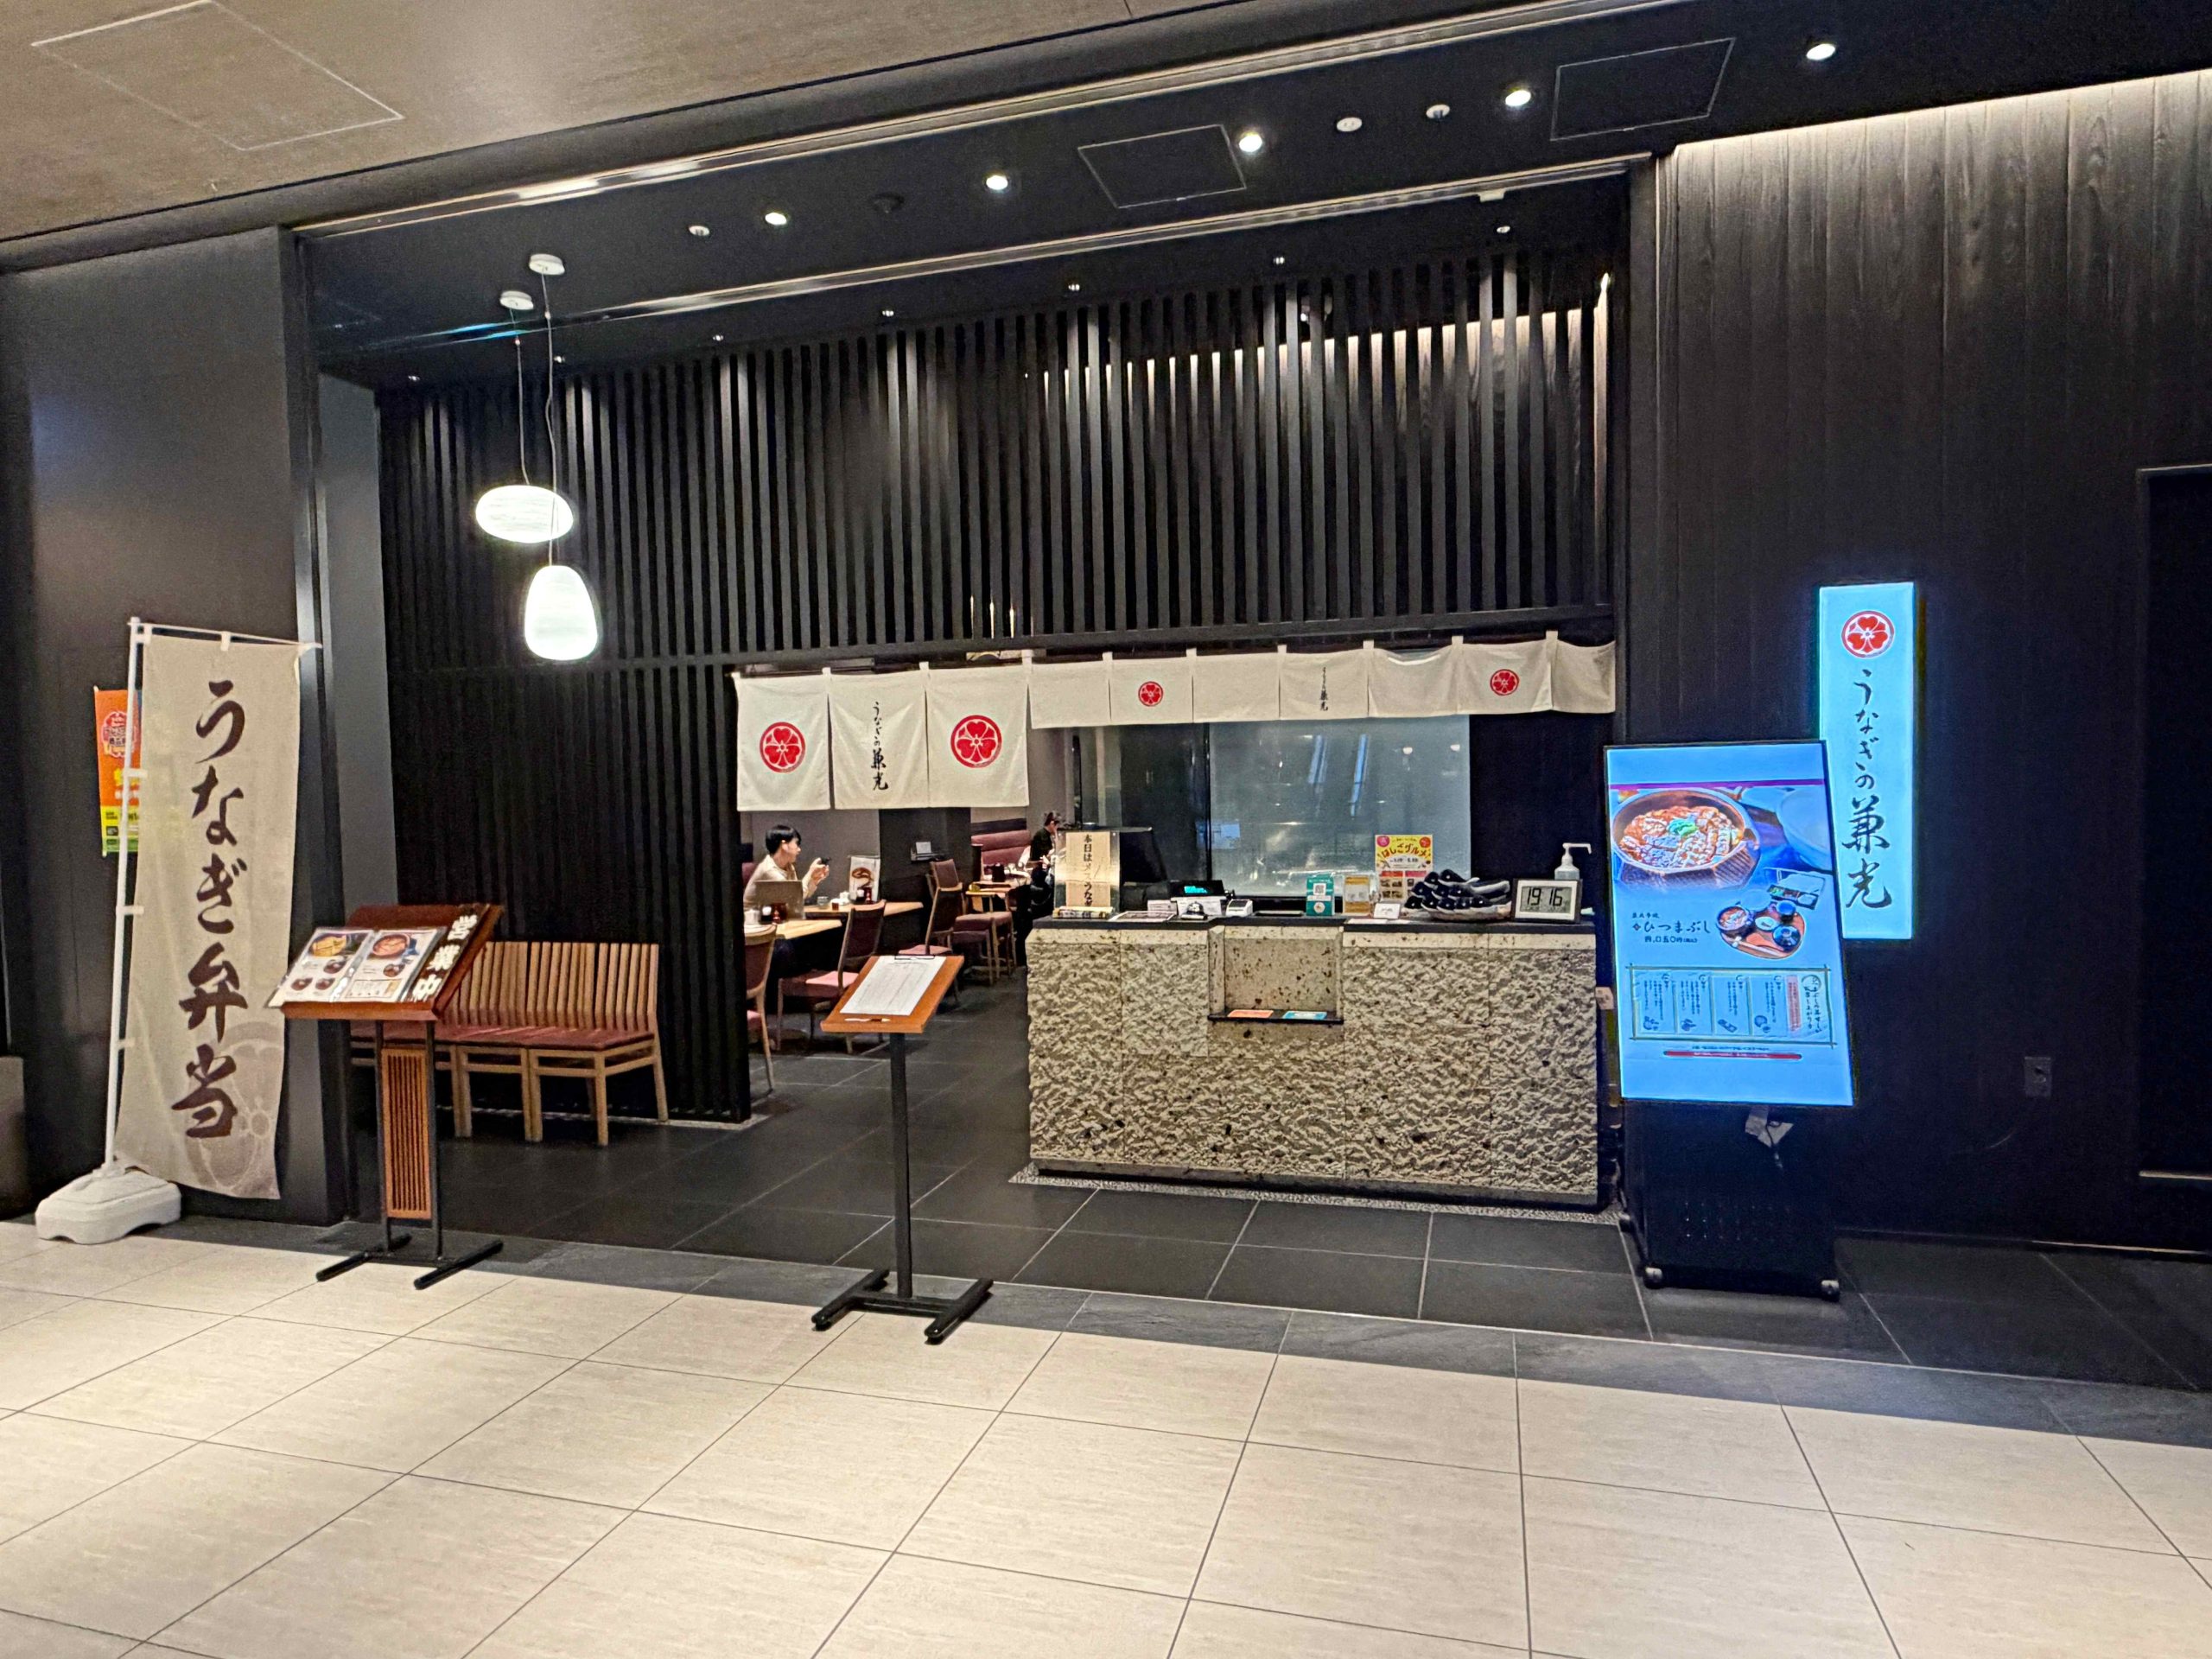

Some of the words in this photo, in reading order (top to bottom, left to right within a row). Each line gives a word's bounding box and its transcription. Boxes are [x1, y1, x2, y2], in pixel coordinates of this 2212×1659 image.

[1841, 669, 1892, 908] うなぎの兼光
[171, 680, 247, 1138] うなぎ弁当
[1644, 920, 1710, 933] ひつまぶし
